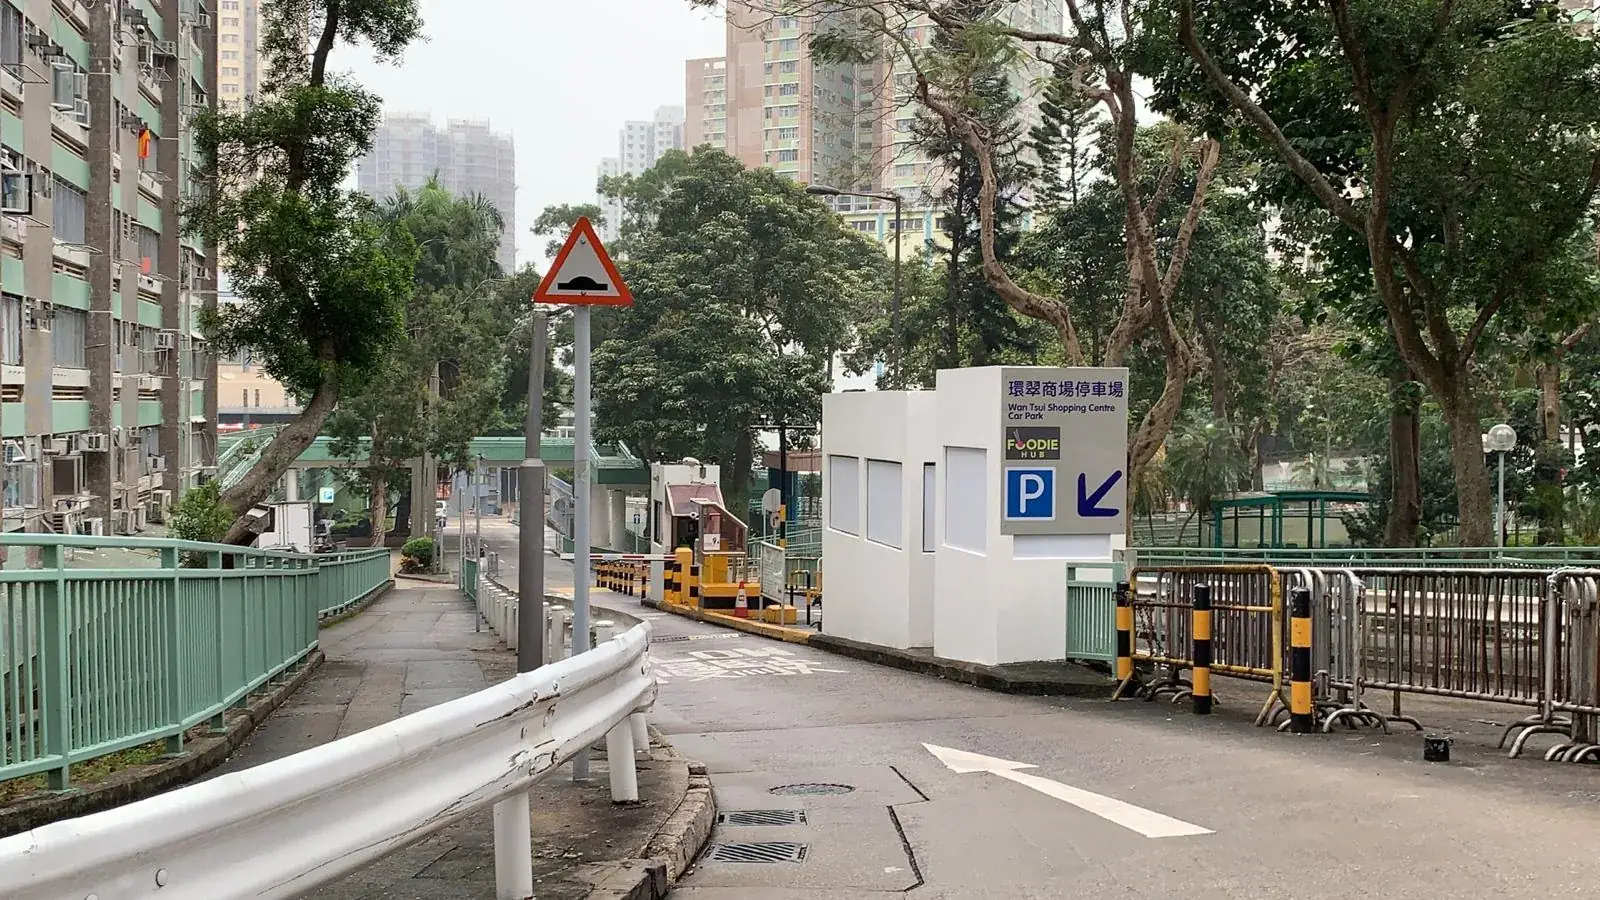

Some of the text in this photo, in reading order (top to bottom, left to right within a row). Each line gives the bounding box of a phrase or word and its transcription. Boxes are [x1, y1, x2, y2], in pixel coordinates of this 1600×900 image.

[1008, 381, 1124, 398] 環翠商場停車場
[1008, 403, 1116, 414] Wan Tsui Shopping Centre
[1008, 412, 1044, 420] Car Park
[1007, 439, 1059, 450] FOODIE
[1019, 474, 1045, 514] P
[649, 646, 796, 664] LOW
